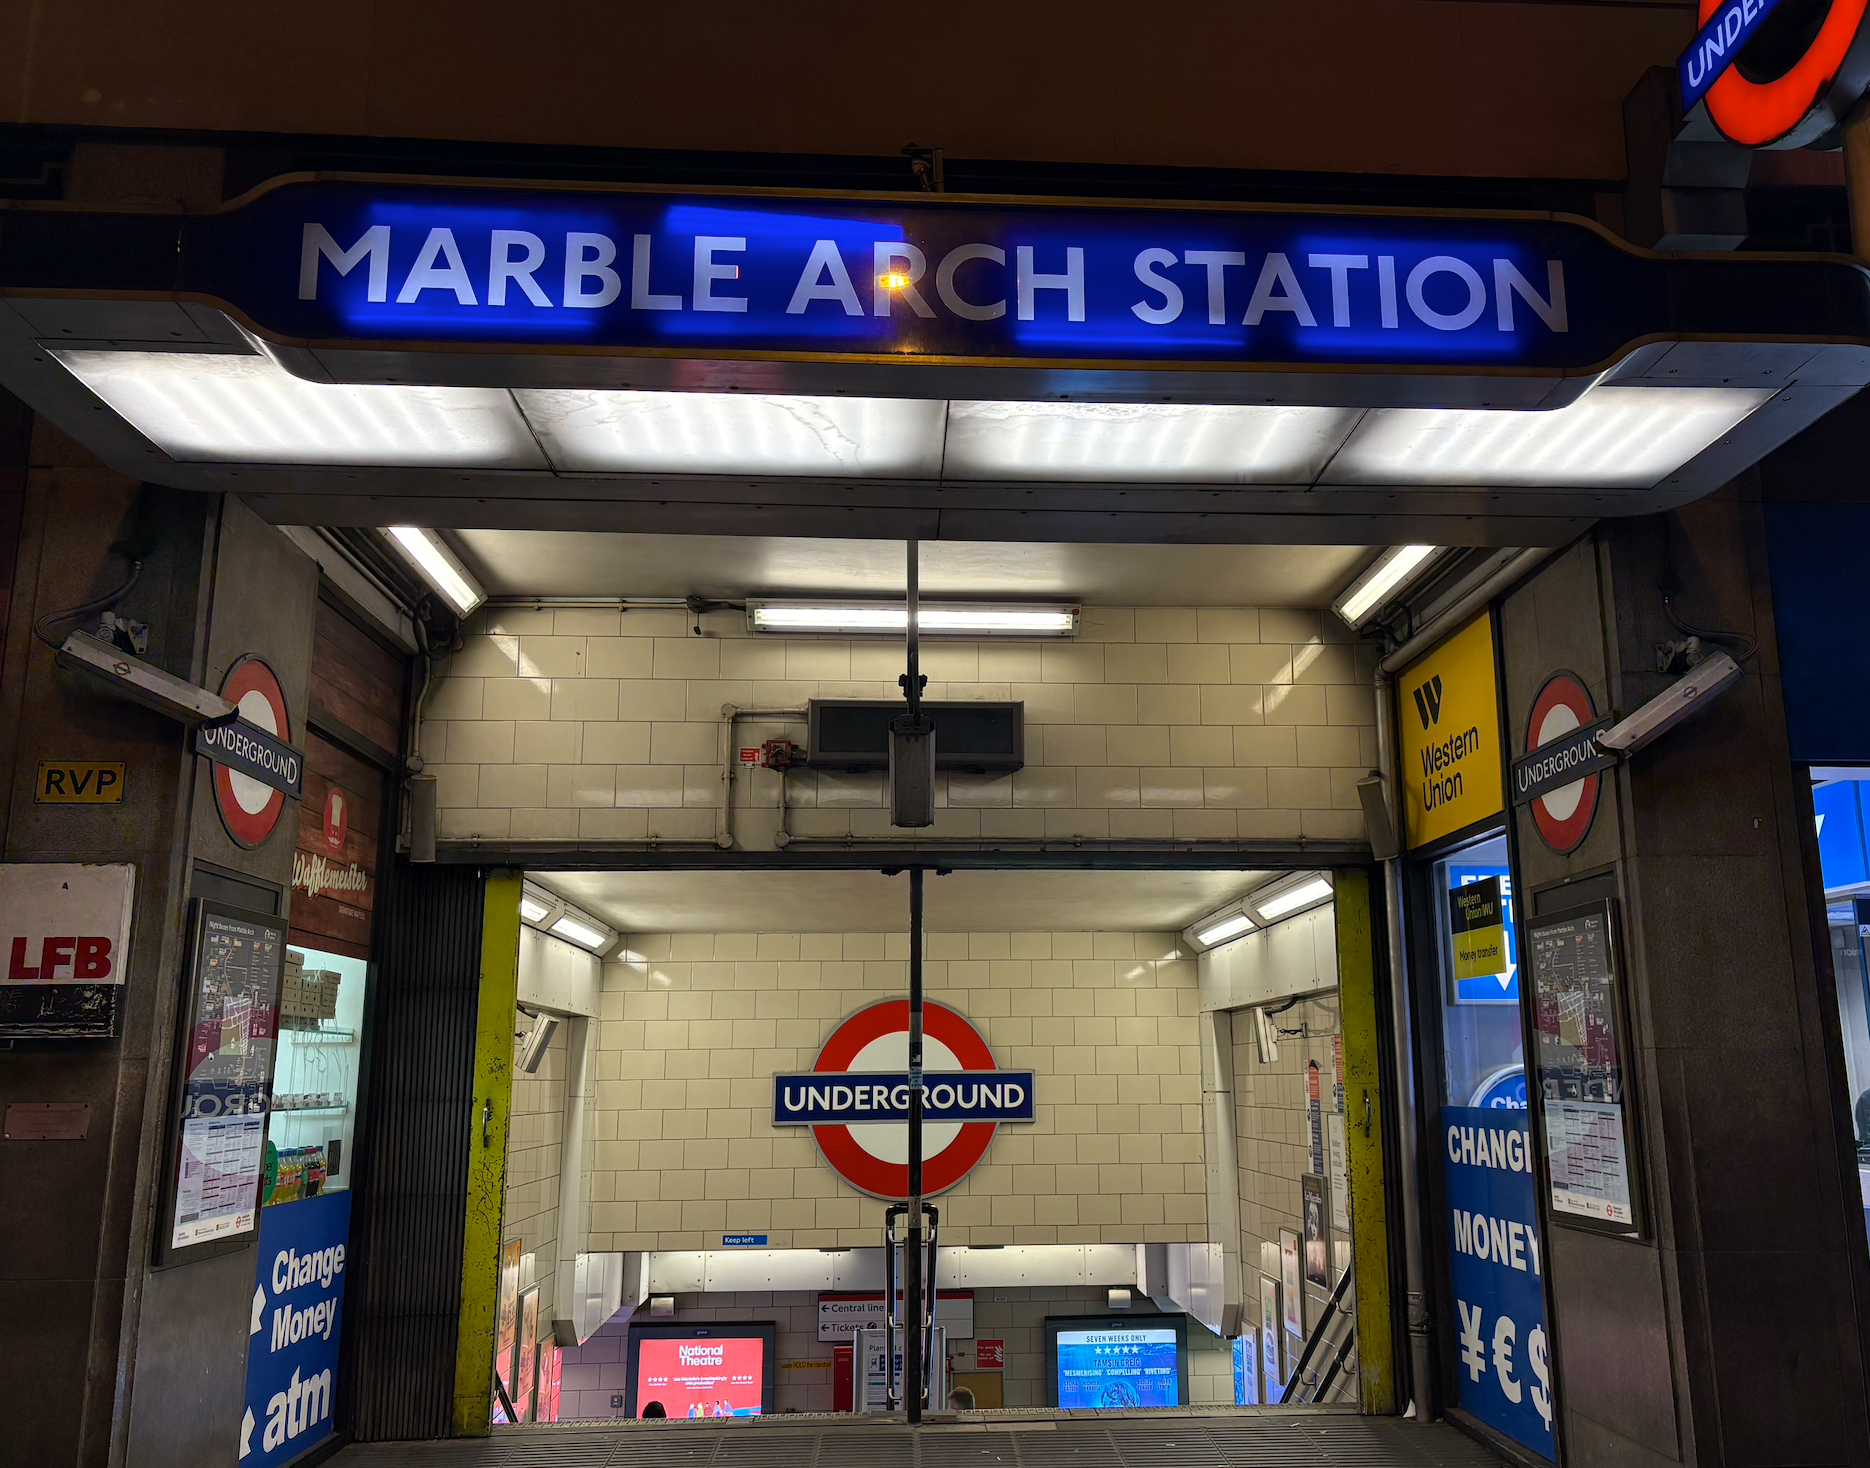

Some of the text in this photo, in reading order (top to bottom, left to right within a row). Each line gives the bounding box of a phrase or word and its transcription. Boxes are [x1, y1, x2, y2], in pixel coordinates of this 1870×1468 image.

[298, 222, 1568, 333] MARBLE ARCH STATION
[204, 727, 297, 785] UNDERGROUND
[1421, 726, 1479, 778] Western
[44, 769, 118, 795] RVP
[1423, 771, 1464, 811] Union
[292, 851, 367, 898] Wafflemeister
[1457, 893, 1481, 908] Western
[9, 936, 112, 979] LFB
[1459, 944, 1498, 962] Money transfer
[784, 1084, 1025, 1112] UNDERGROUND
[724, 1236, 755, 1244] Keep left
[1453, 1208, 1541, 1276] MONEY
[272, 1243, 345, 1295] Change
[831, 1303, 885, 1313] Central line
[270, 1297, 337, 1354] Money
[831, 1323, 864, 1332] Tickets
[1086, 1335, 1106, 1343] SEVEN
[1130, 1334, 1147, 1342] ONLY
[679, 1345, 723, 1356] National
[679, 1356, 723, 1366] Theatre
[1094, 1359, 1119, 1367] TAMSIN
[262, 1365, 331, 1453] atm
